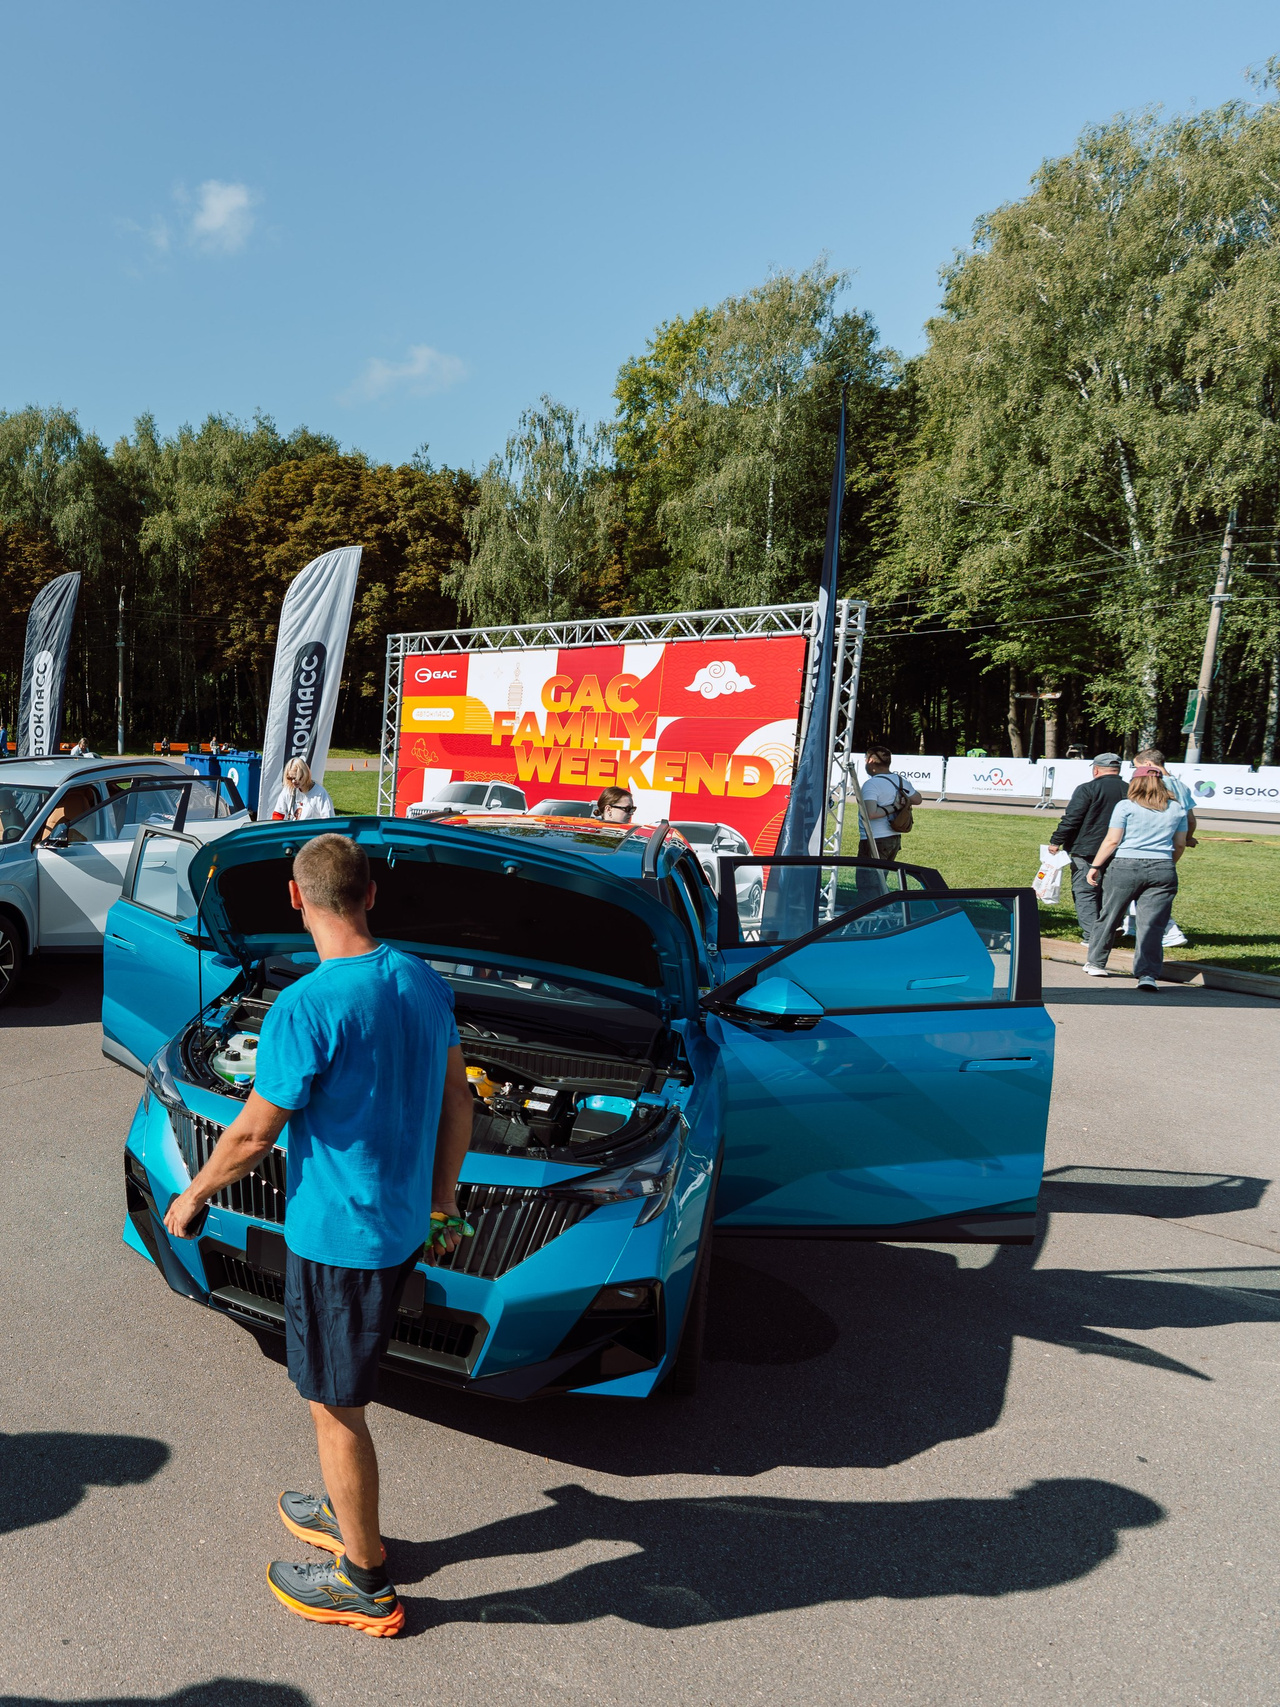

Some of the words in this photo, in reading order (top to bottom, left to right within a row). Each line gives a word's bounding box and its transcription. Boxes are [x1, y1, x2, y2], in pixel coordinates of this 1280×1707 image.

[433, 669, 458, 679] GAC
[540, 673, 642, 713] GAC
[35, 662, 48, 756] ВТОКЛАСС
[291, 654, 319, 761] ТОКЛАСС
[490, 711, 659, 751] FAMILY
[513, 746, 775, 799] WEEKEND
[893, 771, 931, 779] ОКОМ
[1223, 786, 1280, 797] ЭВОКО
